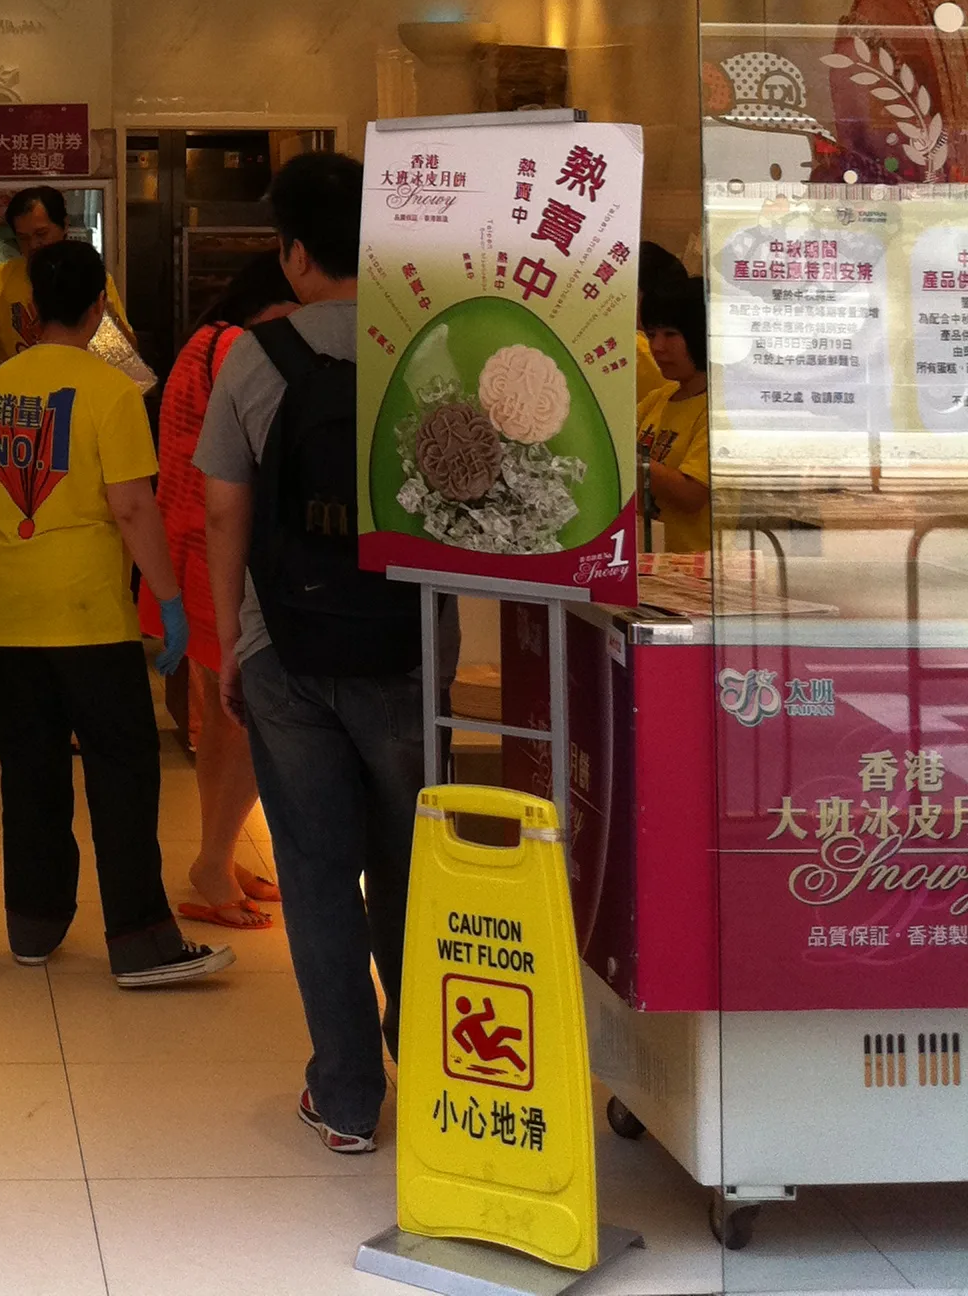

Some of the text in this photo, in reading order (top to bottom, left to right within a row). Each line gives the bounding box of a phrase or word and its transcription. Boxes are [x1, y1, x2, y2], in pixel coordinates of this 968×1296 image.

[12, 152, 65, 170] 換領處
[411, 154, 440, 169] 香港
[381, 170, 467, 187] 大班冰皮月餅
[512, 158, 537, 224] 熱賣中
[386, 184, 457, 214] Snowy
[512, 145, 608, 301] 熱賣中
[597, 203, 621, 233] Taipan
[769, 239, 838, 259] 中秋期間
[582, 240, 631, 301] 熱賣中
[733, 260, 874, 281] 產品供應特別安排
[785, 678, 835, 704] 大班
[785, 704, 835, 716] TAIPAN
[858, 750, 946, 793] 香港
[448, 911, 522, 942] CAUTION
[437, 938, 535, 974] WET FLOOR
[433, 1089, 547, 1152] 小心地滑
